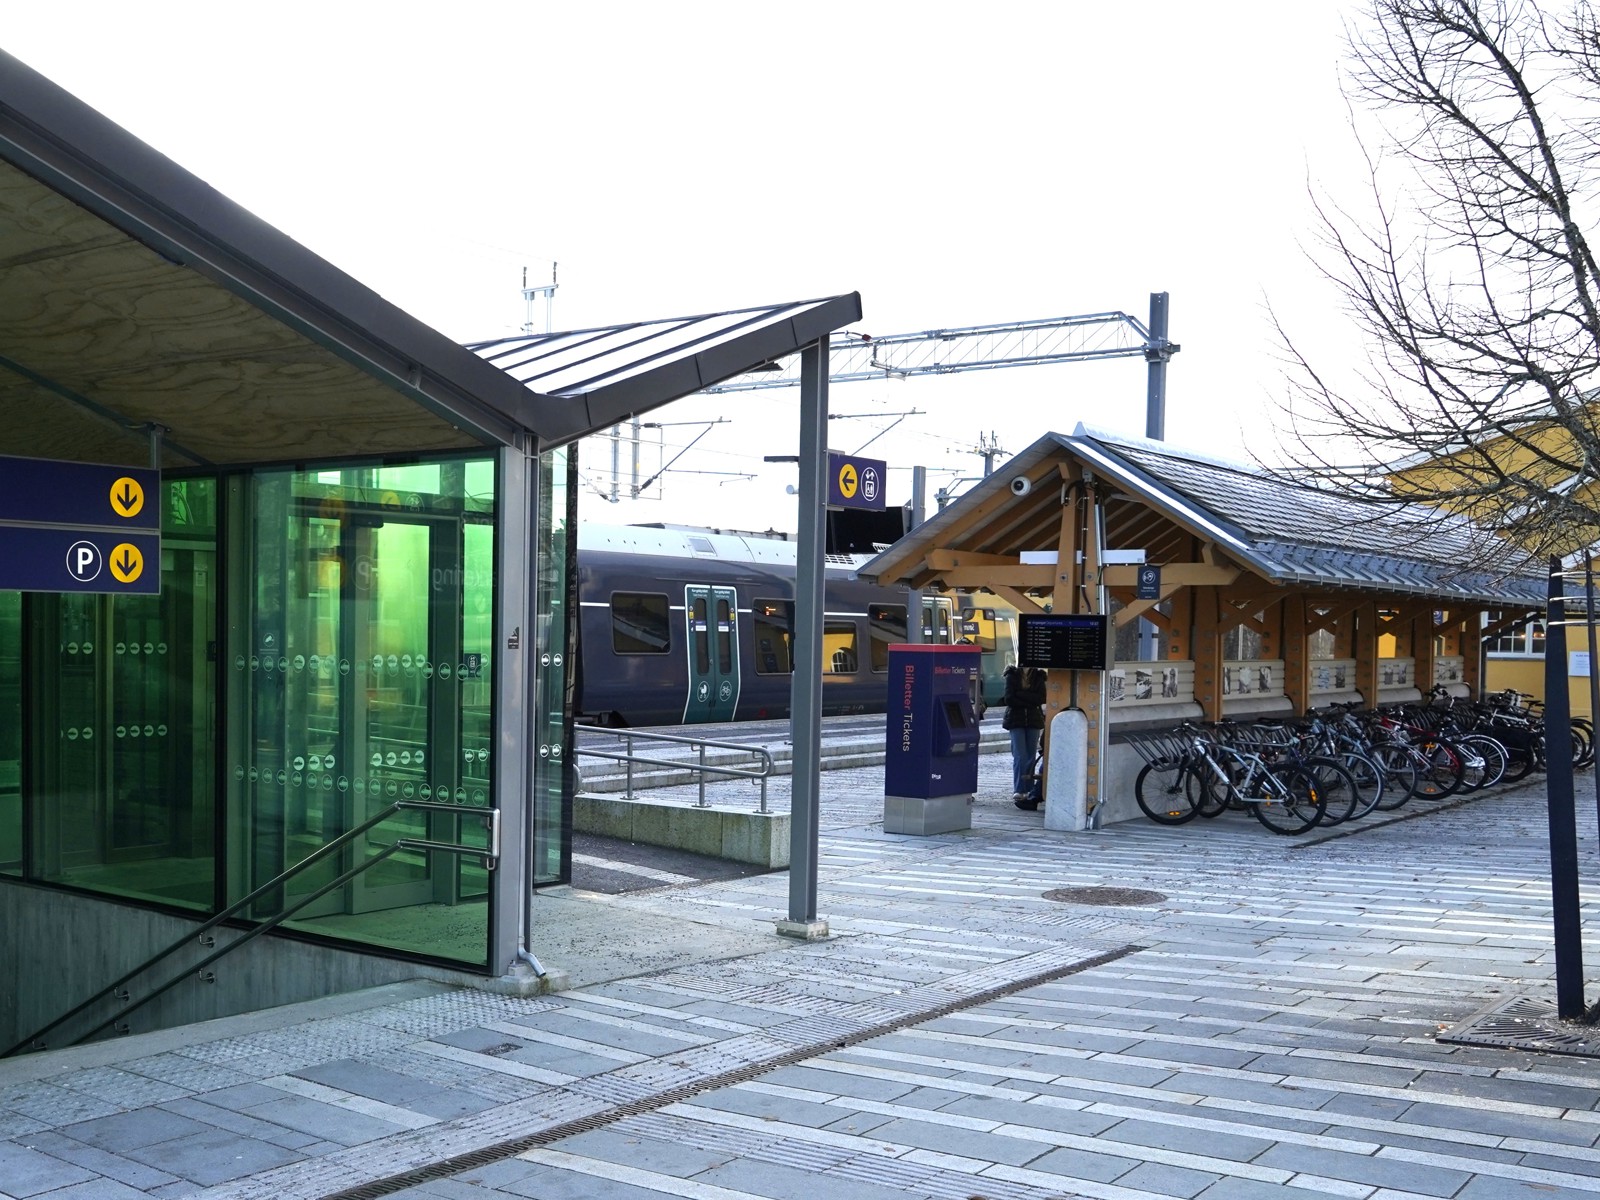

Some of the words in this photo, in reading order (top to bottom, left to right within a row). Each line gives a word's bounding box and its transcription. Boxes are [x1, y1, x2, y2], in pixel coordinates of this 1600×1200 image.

[77, 548, 94, 575] P
[934, 666, 951, 675] Billetter
[951, 666, 966, 675] Tickets
[904, 665, 914, 711] Billetter
[902, 713, 913, 752] Tickets
